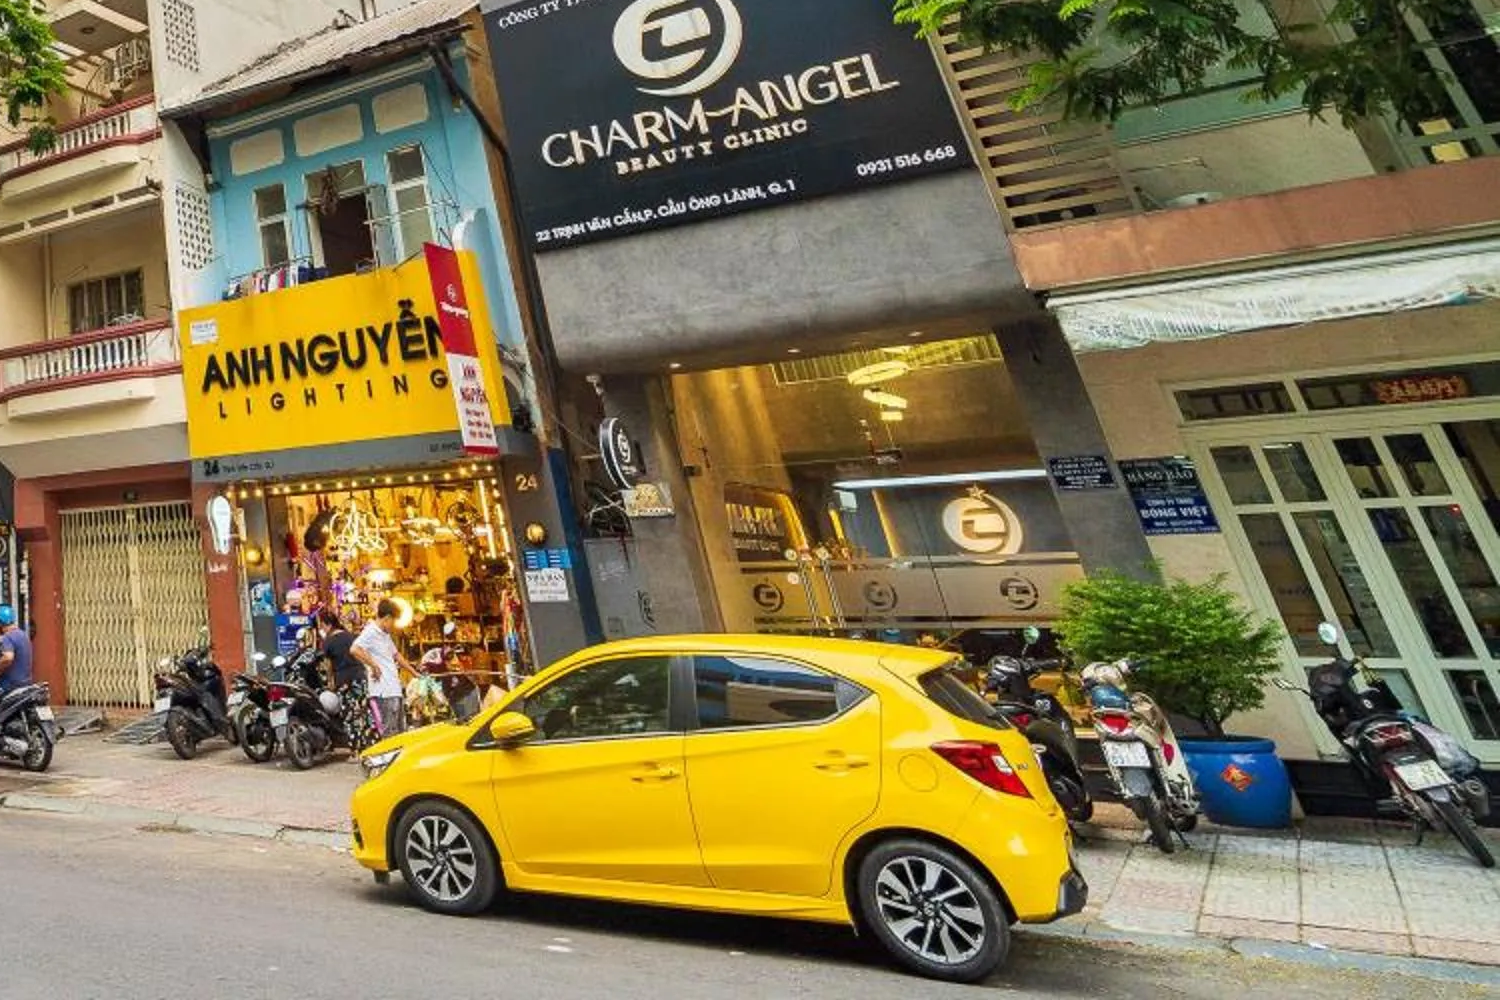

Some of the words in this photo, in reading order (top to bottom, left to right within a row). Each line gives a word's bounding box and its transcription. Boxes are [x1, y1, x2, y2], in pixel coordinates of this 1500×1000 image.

[498, 7, 539, 29] CÔNG
[615, 141, 713, 175] BEAUTY
[723, 118, 808, 150] CLINIC
[856, 158, 893, 177] 0931
[895, 153, 922, 168] 516
[924, 145, 957, 162] 668
[201, 344, 275, 393] ANH
[219, 369, 449, 419] LIGHTING
